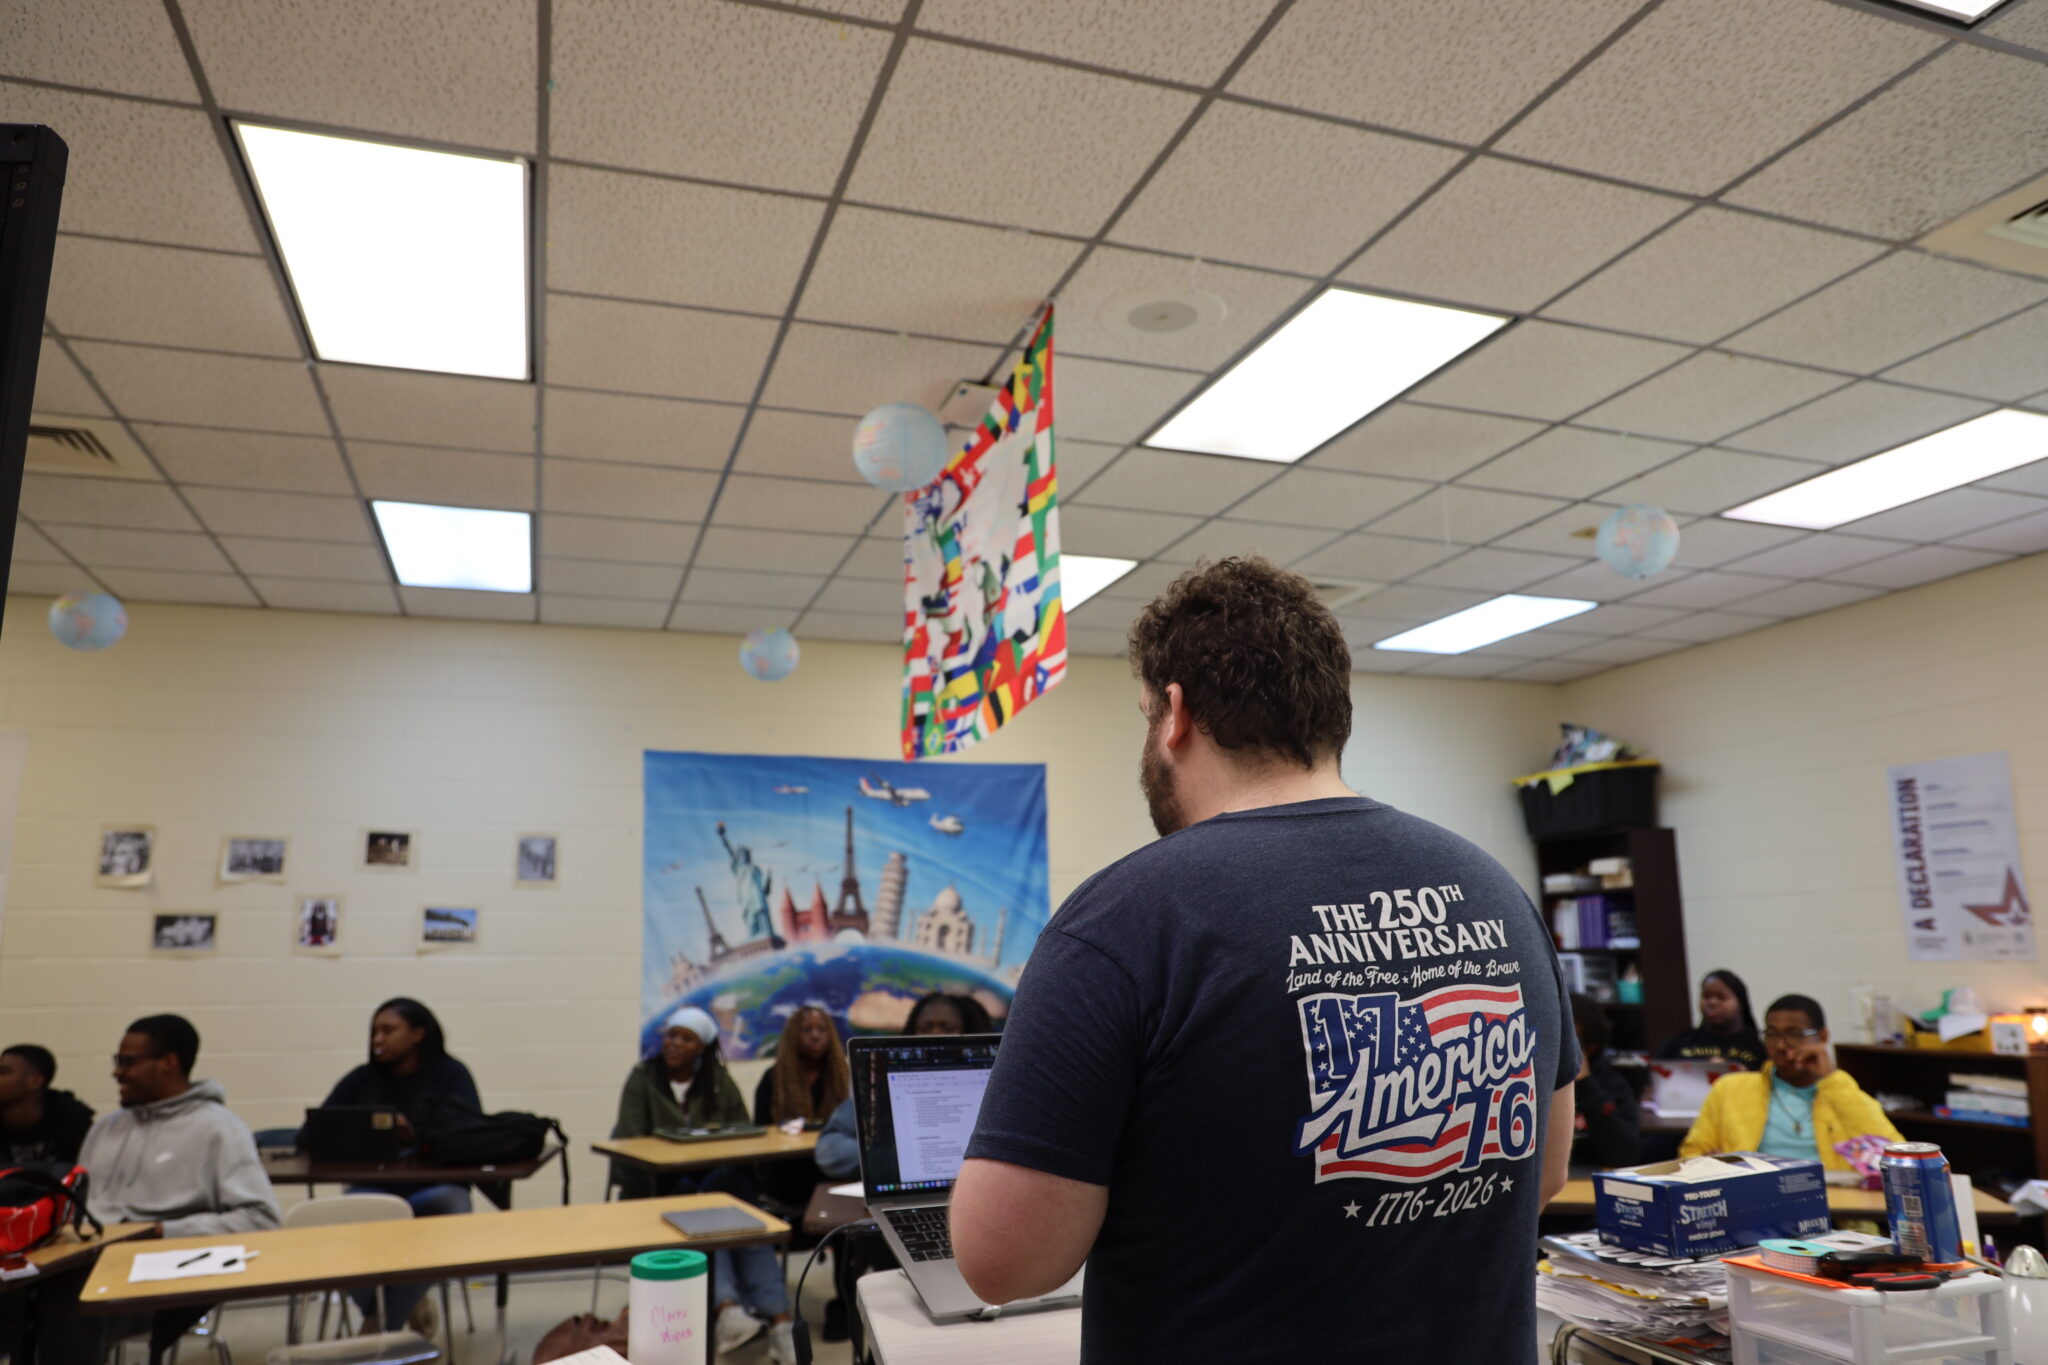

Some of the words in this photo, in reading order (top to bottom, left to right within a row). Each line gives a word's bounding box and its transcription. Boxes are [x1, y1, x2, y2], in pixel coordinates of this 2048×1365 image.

[1896, 777, 1934, 910] DECLARATION
[1312, 903, 1373, 932] THE
[1369, 884, 1465, 929] 250TH
[1913, 917, 1937, 932] A
[1288, 919, 1509, 967] ANNIVERSARY
[1286, 968, 1322, 994] Land
[1324, 970, 1342, 989] of
[1342, 971, 1365, 987] the
[1364, 965, 1400, 988] Free
[1410, 965, 1446, 989] Home
[1447, 959, 1463, 979] of
[1463, 960, 1482, 976] the
[1485, 958, 1520, 978] Brave
[1296, 1008, 1537, 1157] America
[1454, 1081, 1537, 1173] 76
[1365, 1172, 1498, 1227] 1776-2026
[1679, 1199, 1728, 1225] STRETCH
